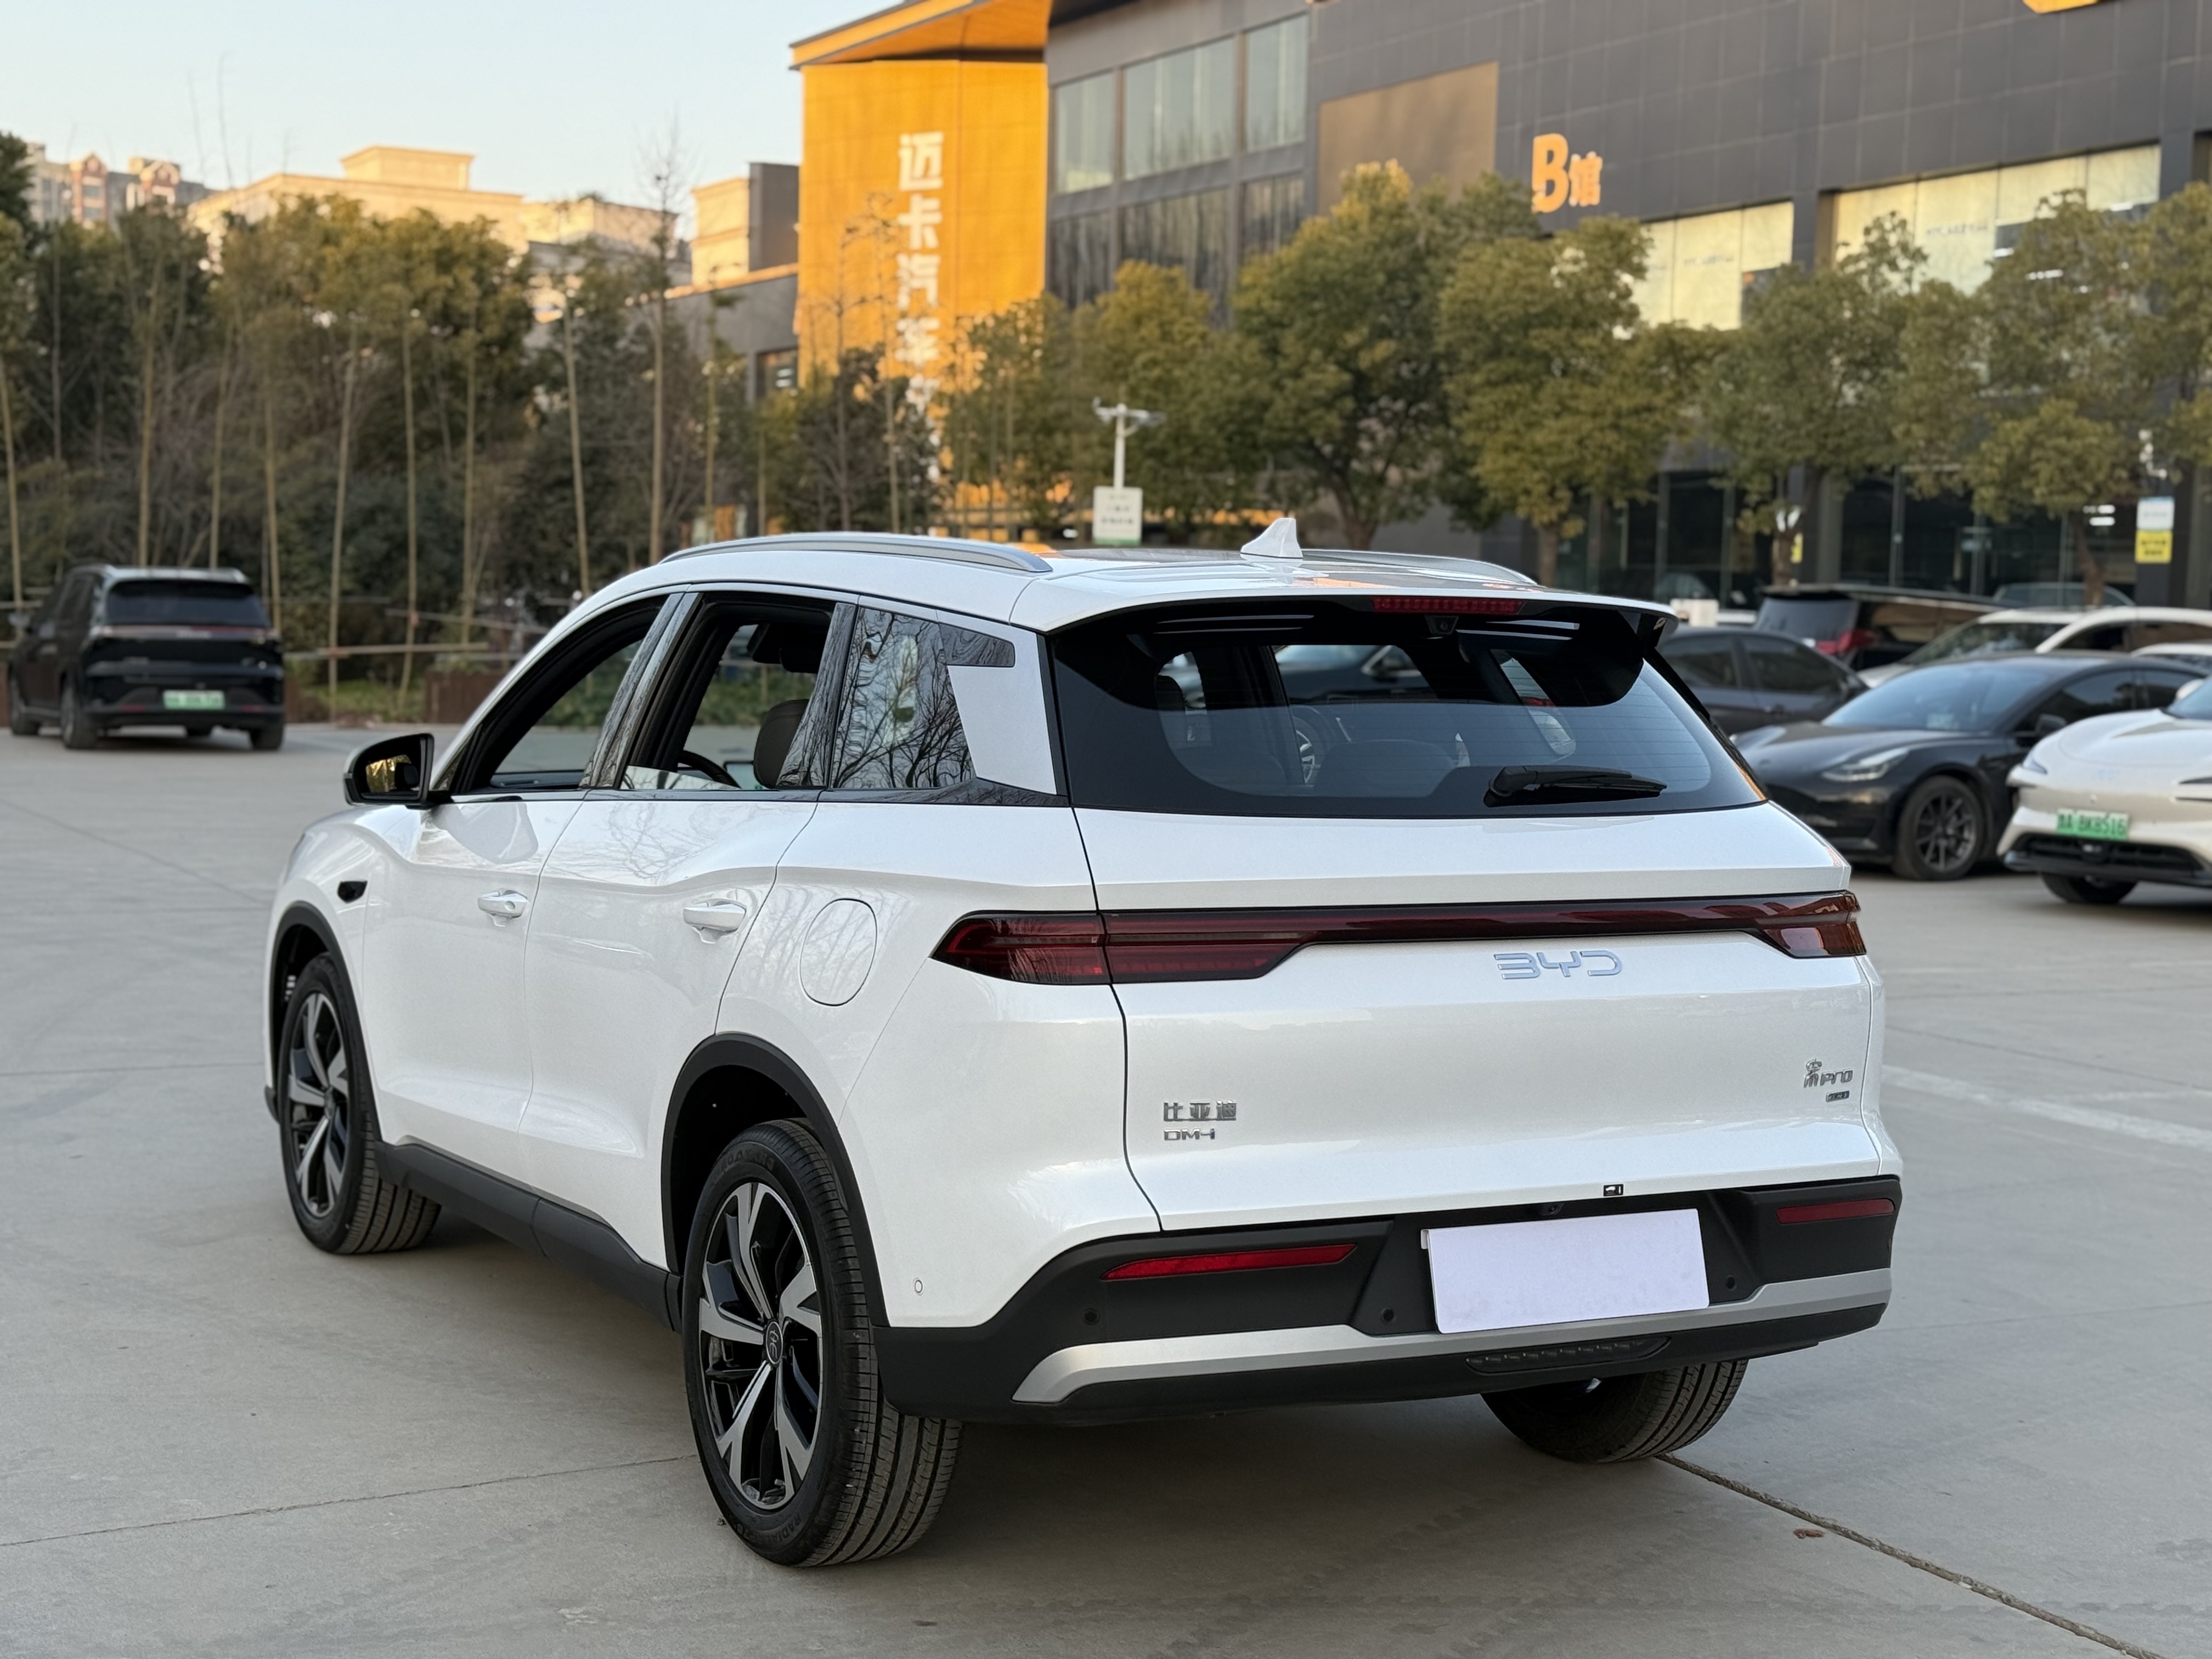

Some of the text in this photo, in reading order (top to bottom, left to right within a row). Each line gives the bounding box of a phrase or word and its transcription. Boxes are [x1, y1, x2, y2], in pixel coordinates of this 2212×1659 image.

[895, 131, 944, 483] 迈卡汽车
[1494, 950, 1622, 979] BYD
[1163, 1100, 1237, 1121] 比亚迪
[1164, 1127, 1215, 1141] DM-i
[769, 1329, 779, 1359] BYD
